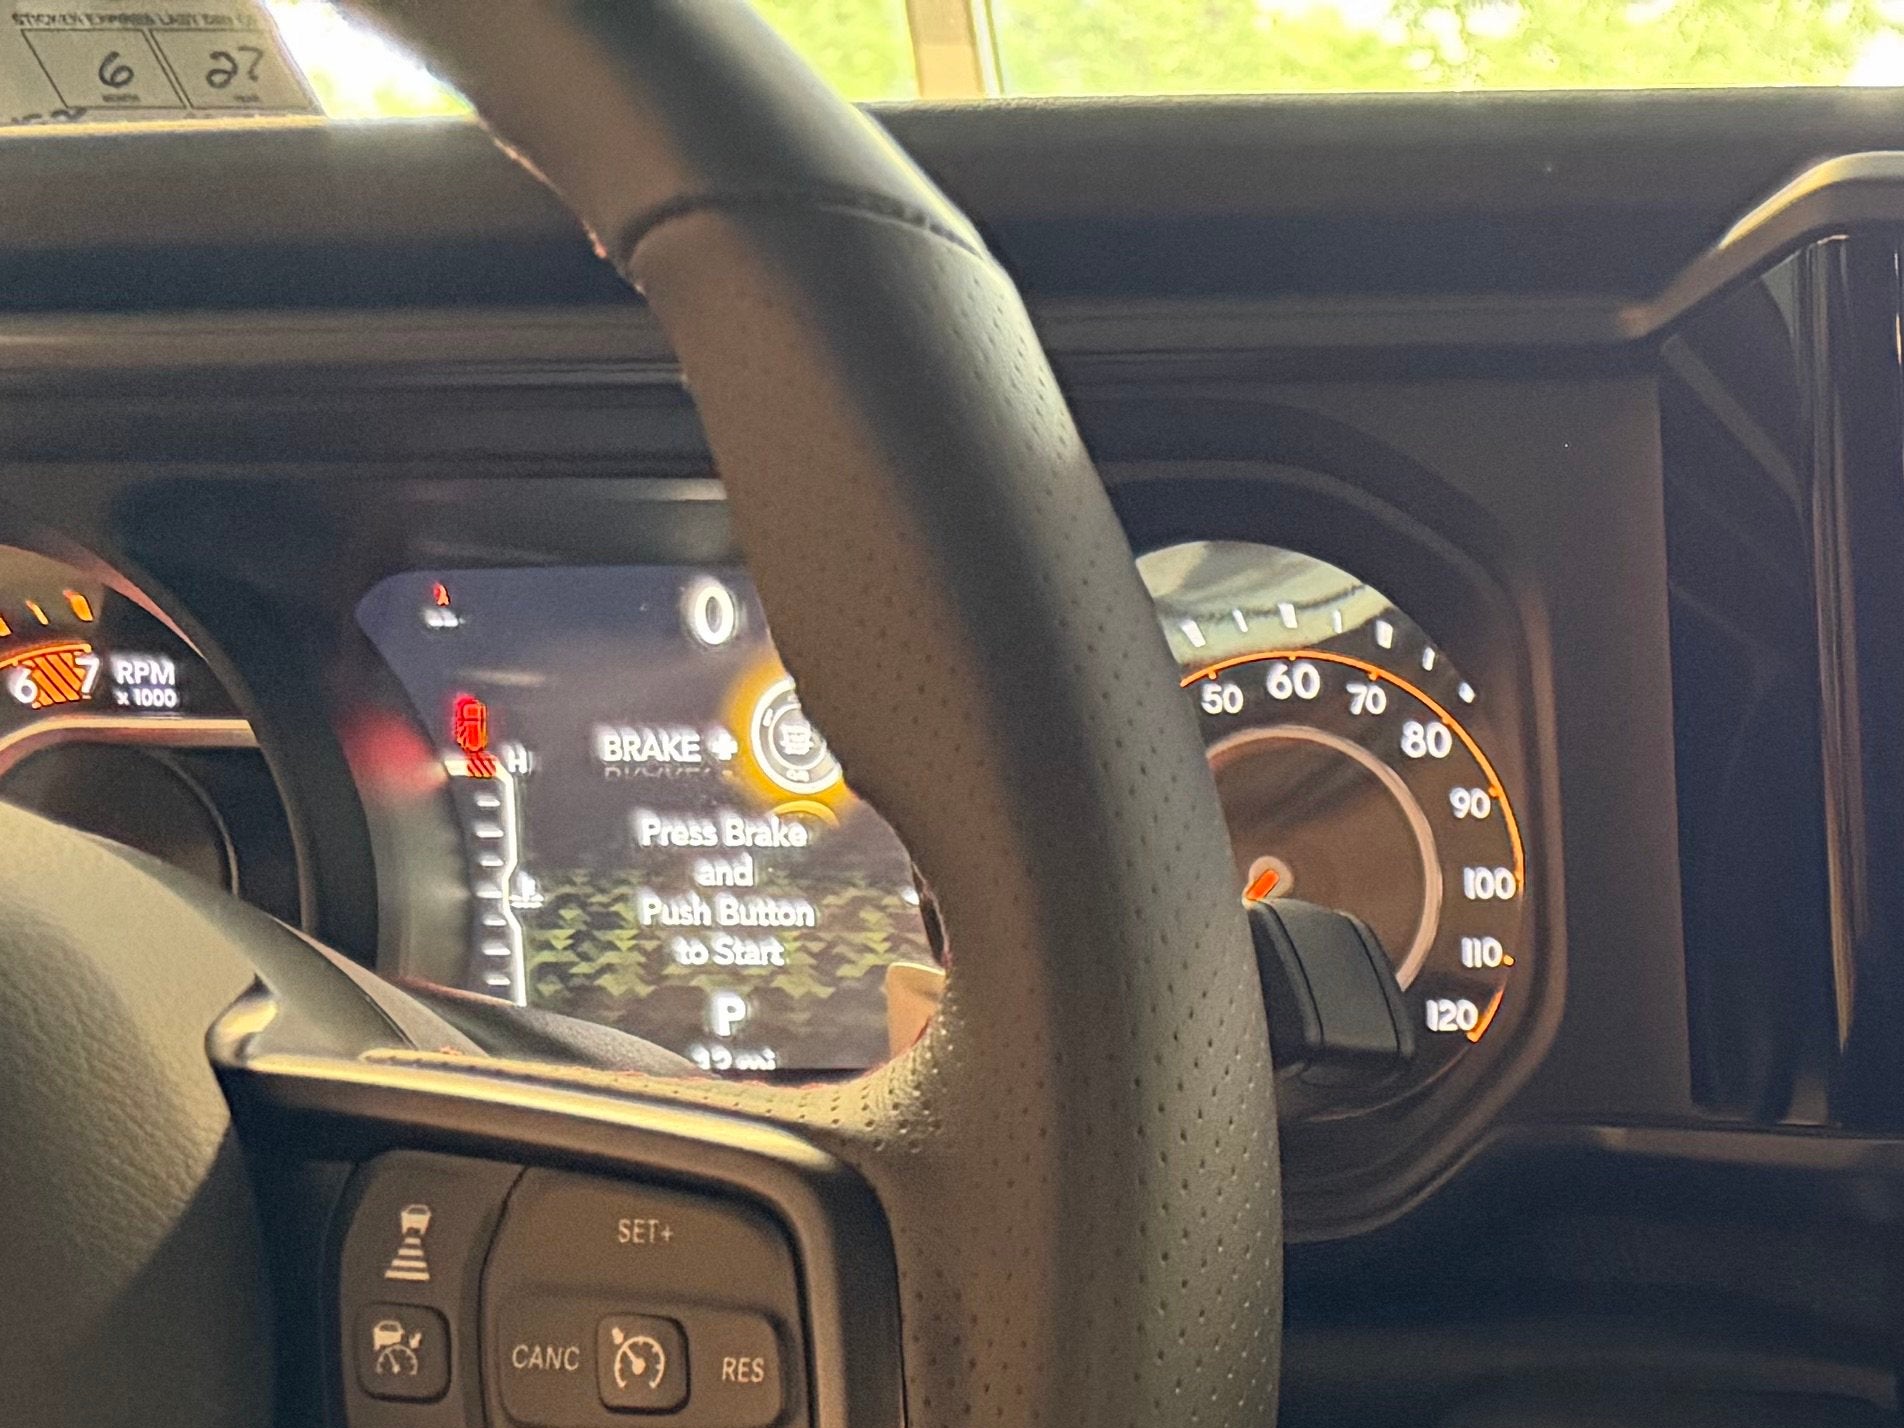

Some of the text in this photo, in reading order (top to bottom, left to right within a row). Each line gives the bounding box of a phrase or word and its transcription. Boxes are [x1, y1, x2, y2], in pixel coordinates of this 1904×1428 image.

[98, 51, 134, 88] 6
[206, 45, 263, 89] 27
[692, 585, 736, 648] 0
[13, 667, 39, 704] 6
[74, 656, 100, 694] 7
[113, 658, 177, 686] RPM
[1266, 664, 1320, 700] 60
[133, 688, 179, 708] 1000
[1201, 683, 1243, 715] 50
[1346, 683, 1386, 715] 70
[600, 732, 702, 763] BRAKE
[1400, 721, 1452, 758] 80
[505, 745, 530, 775] H
[1449, 788, 1490, 819] 90
[638, 816, 809, 848] Press Brake
[695, 854, 754, 887] and
[1463, 867, 1516, 901] 100
[641, 894, 816, 928] Push Button
[676, 938, 786, 967] to Start
[1461, 937, 1502, 968] 110
[713, 993, 747, 1037] P
[1426, 998, 1478, 1032] 120
[618, 1219, 674, 1244] SET+
[512, 1345, 580, 1371] CANC
[722, 1357, 765, 1383] RES
